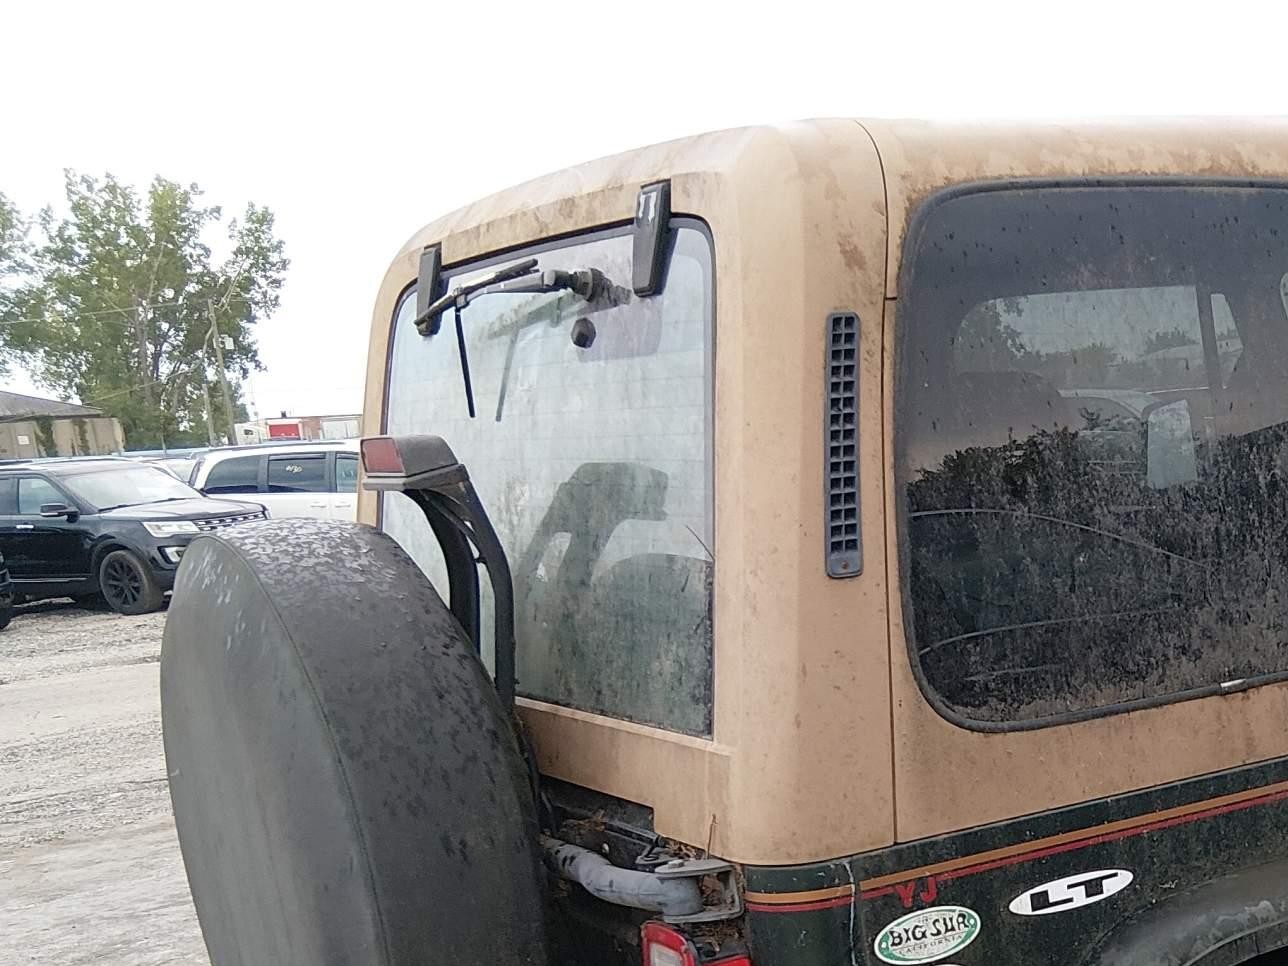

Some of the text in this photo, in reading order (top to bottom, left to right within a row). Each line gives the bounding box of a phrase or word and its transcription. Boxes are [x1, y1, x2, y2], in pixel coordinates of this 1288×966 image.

[895, 876, 938, 908] YJ
[1029, 871, 1119, 912] LT
[888, 912, 970, 947] BIG SUR
